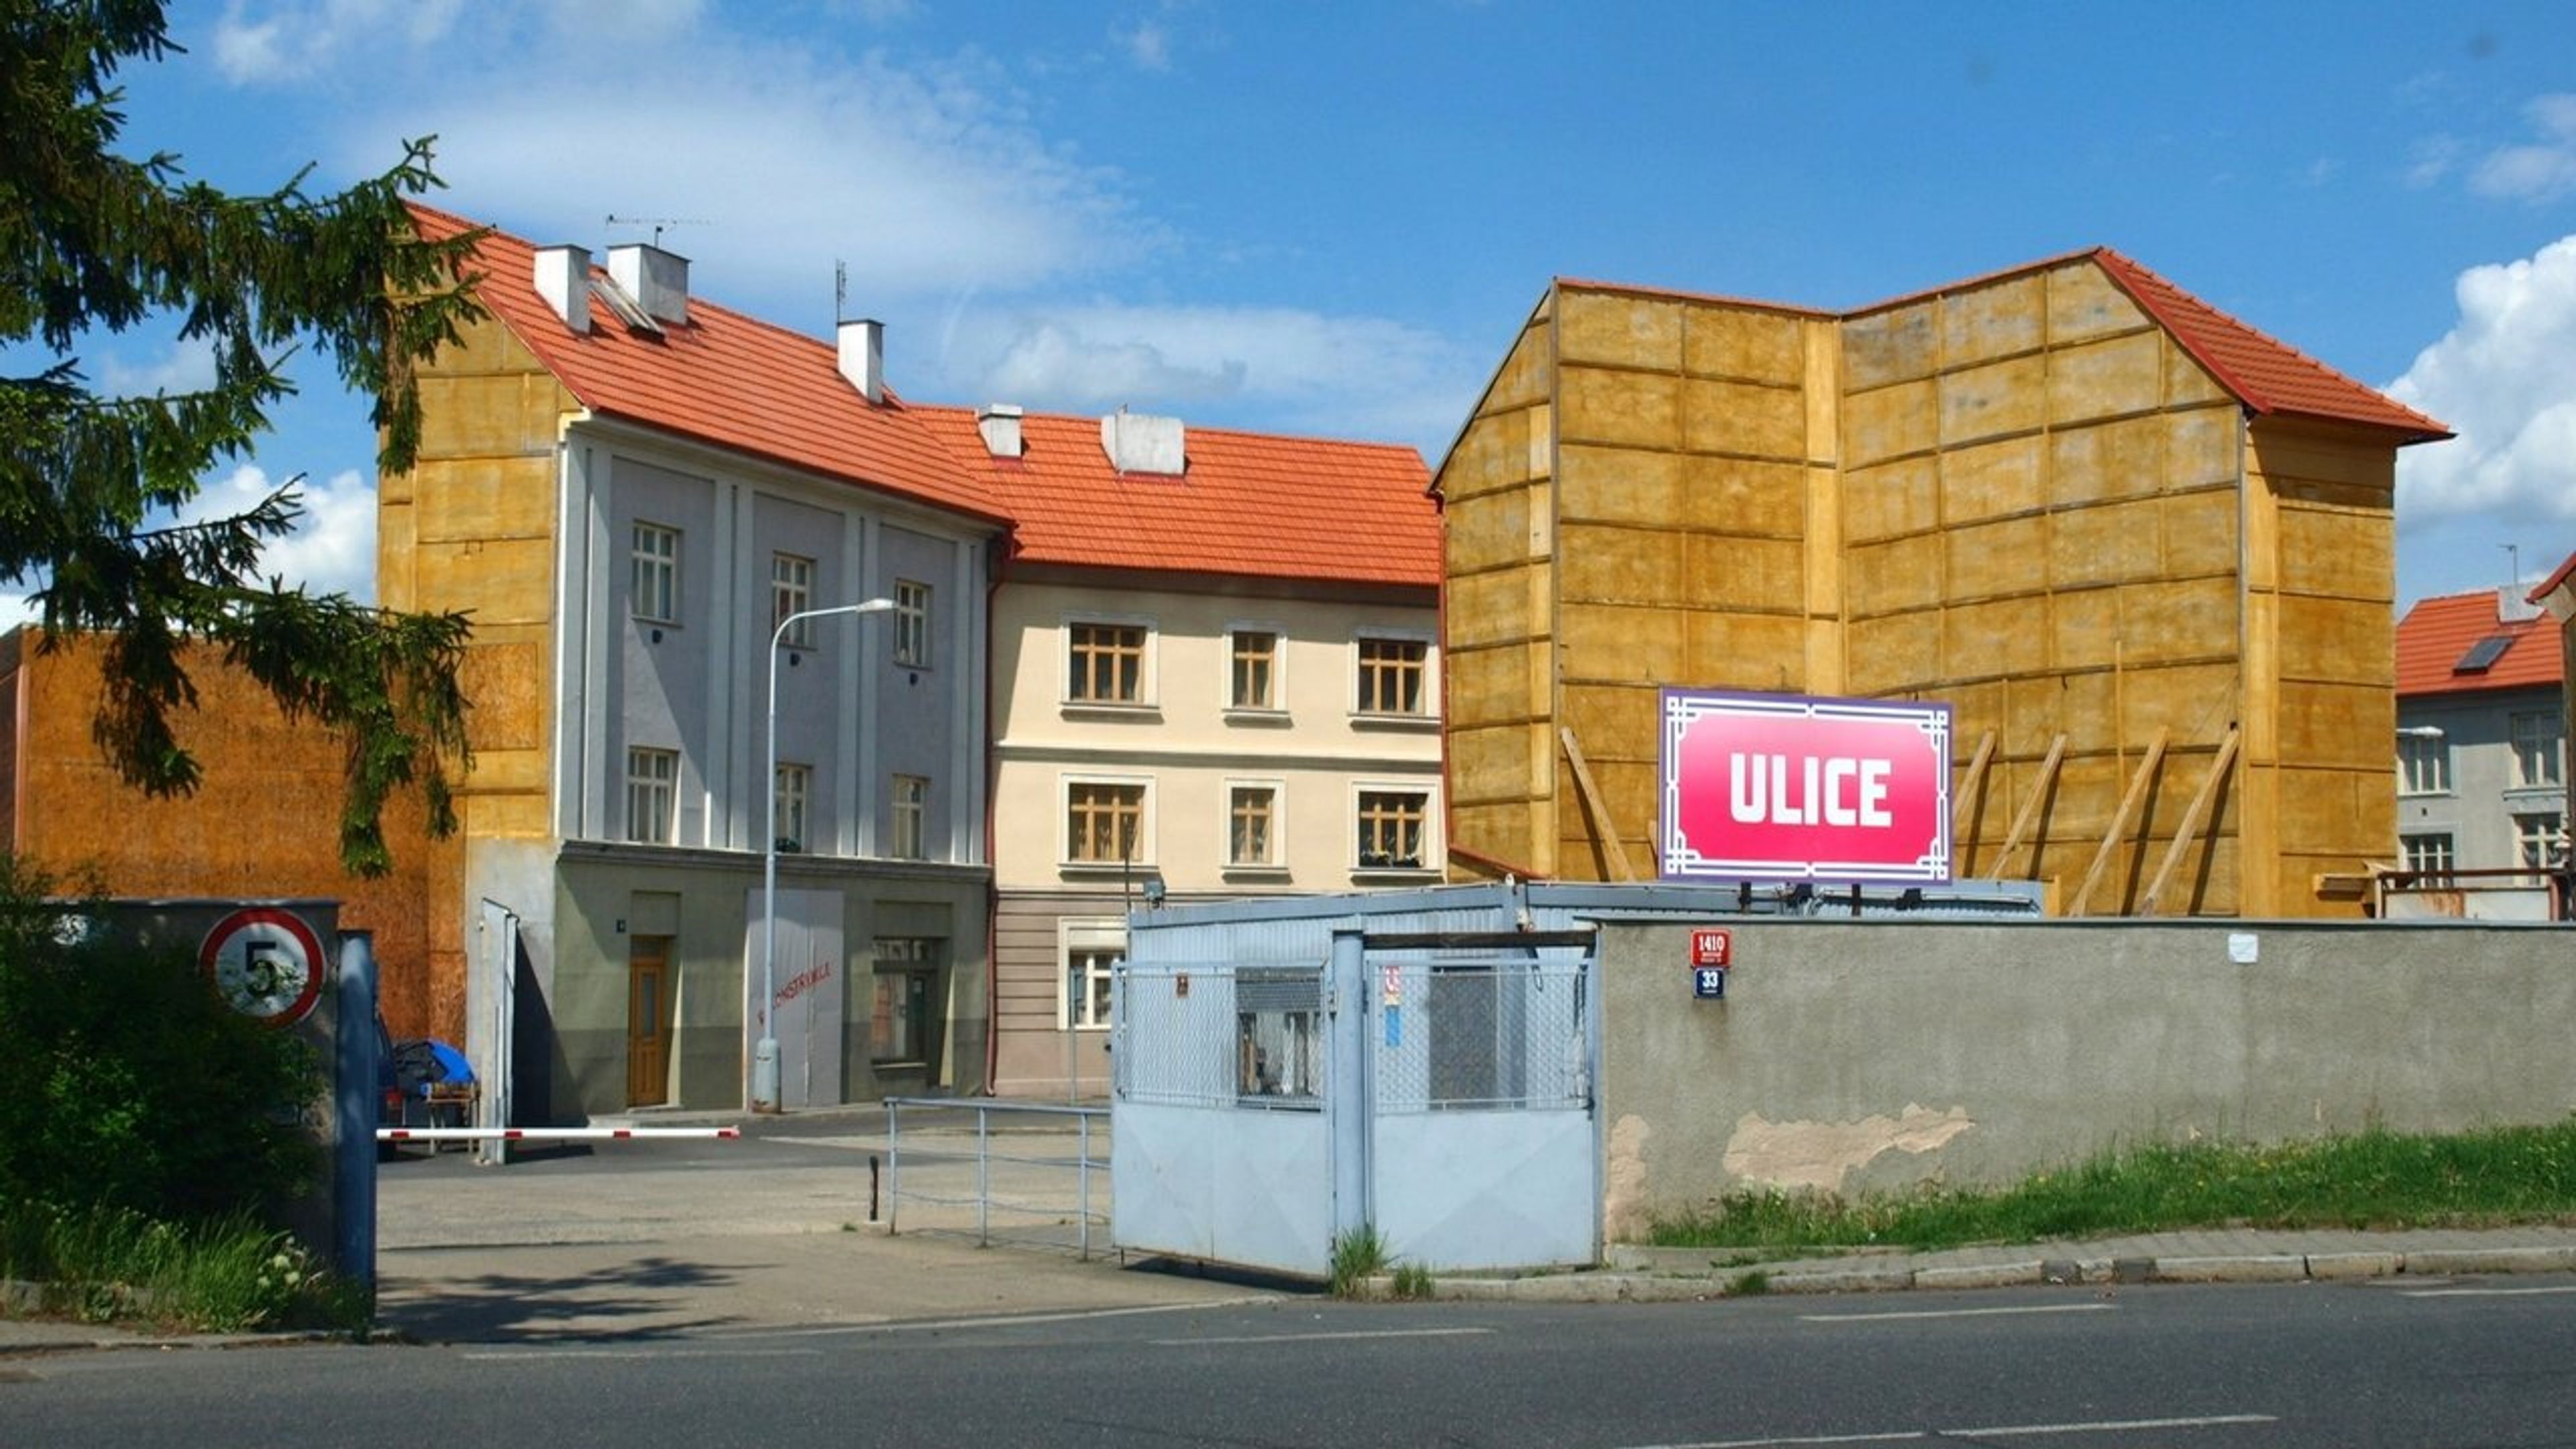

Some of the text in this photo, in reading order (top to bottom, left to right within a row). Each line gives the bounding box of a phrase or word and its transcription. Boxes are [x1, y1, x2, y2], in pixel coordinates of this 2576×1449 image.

[1730, 753, 1892, 827] ULICE
[1699, 934, 1725, 951] 1410
[245, 941, 277, 998] 5
[1702, 971, 1718, 987] 33
